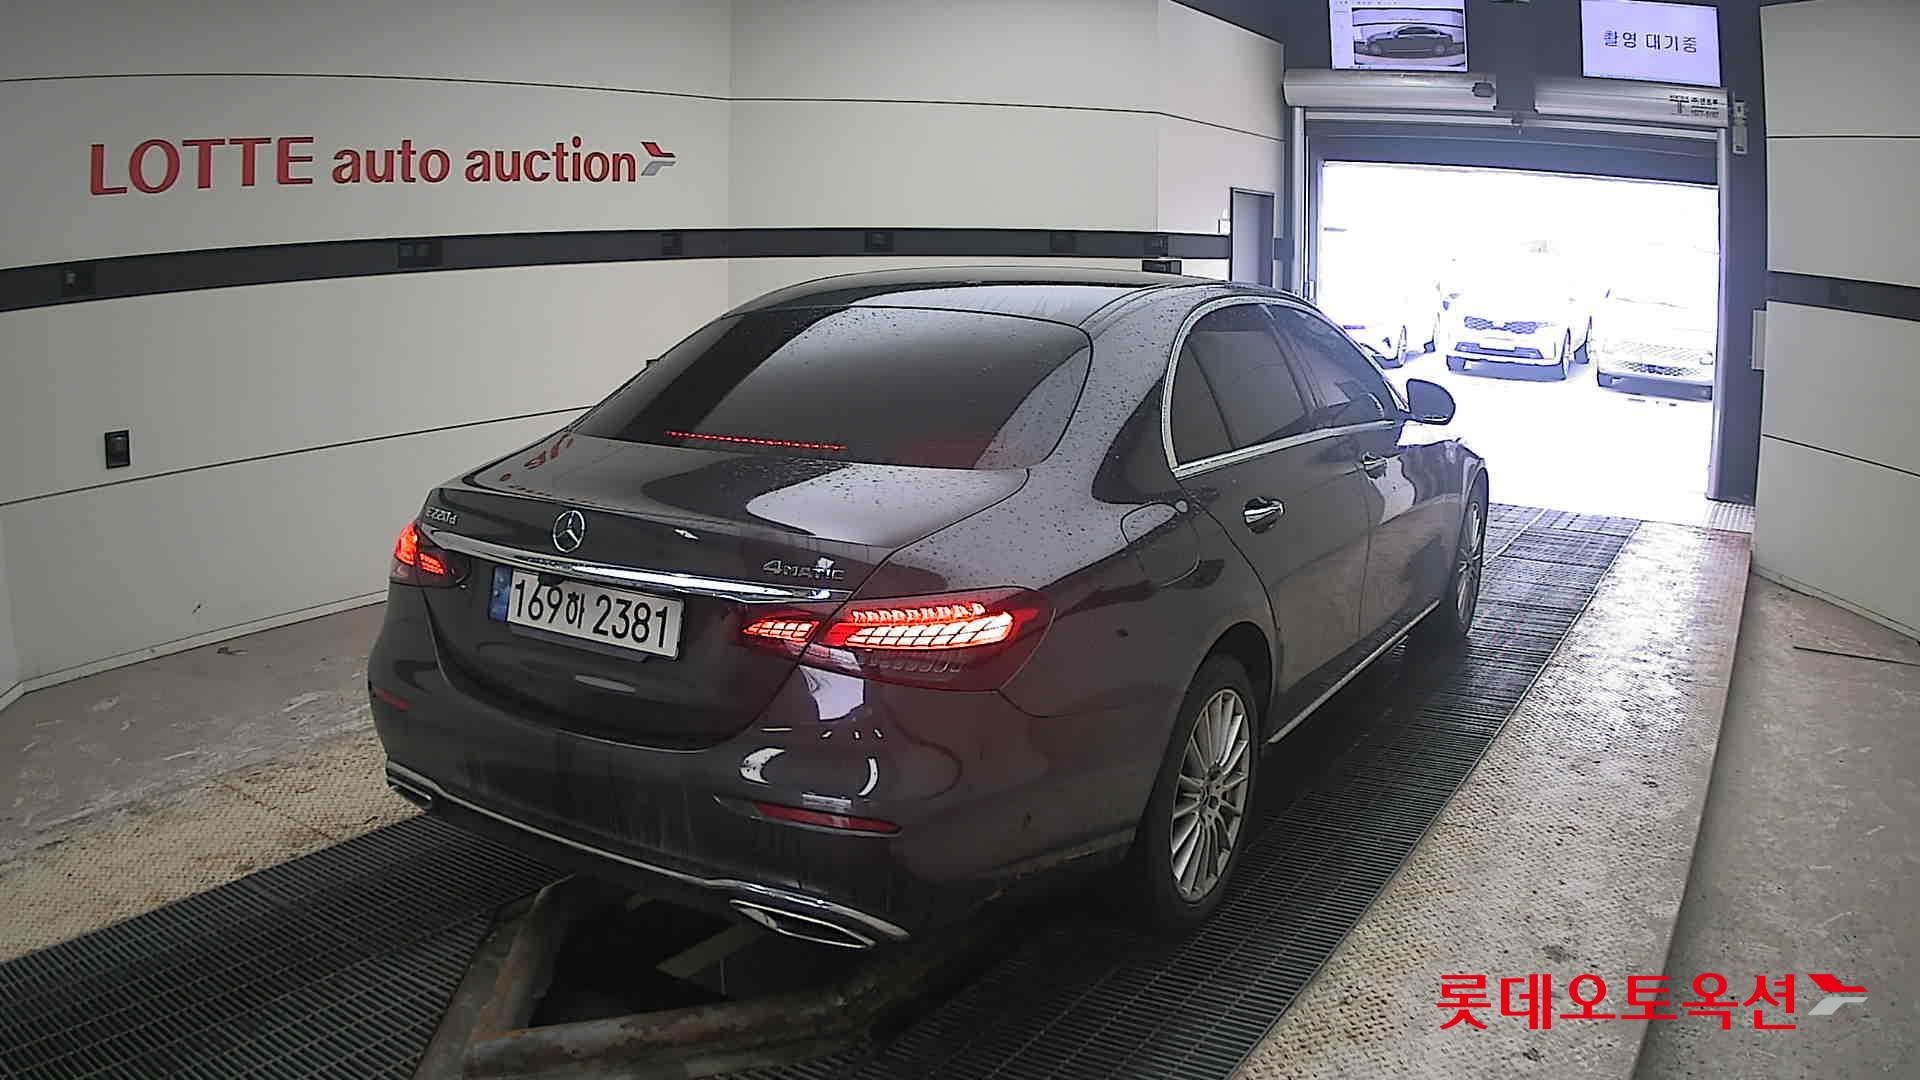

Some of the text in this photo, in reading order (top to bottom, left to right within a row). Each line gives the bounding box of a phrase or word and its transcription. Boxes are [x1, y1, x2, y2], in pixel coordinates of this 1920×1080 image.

[1603, 30, 1697, 54] 촬영 대기중
[88, 135, 637, 196] LOTTE auto auction
[514, 578, 669, 649] 169하 2381
